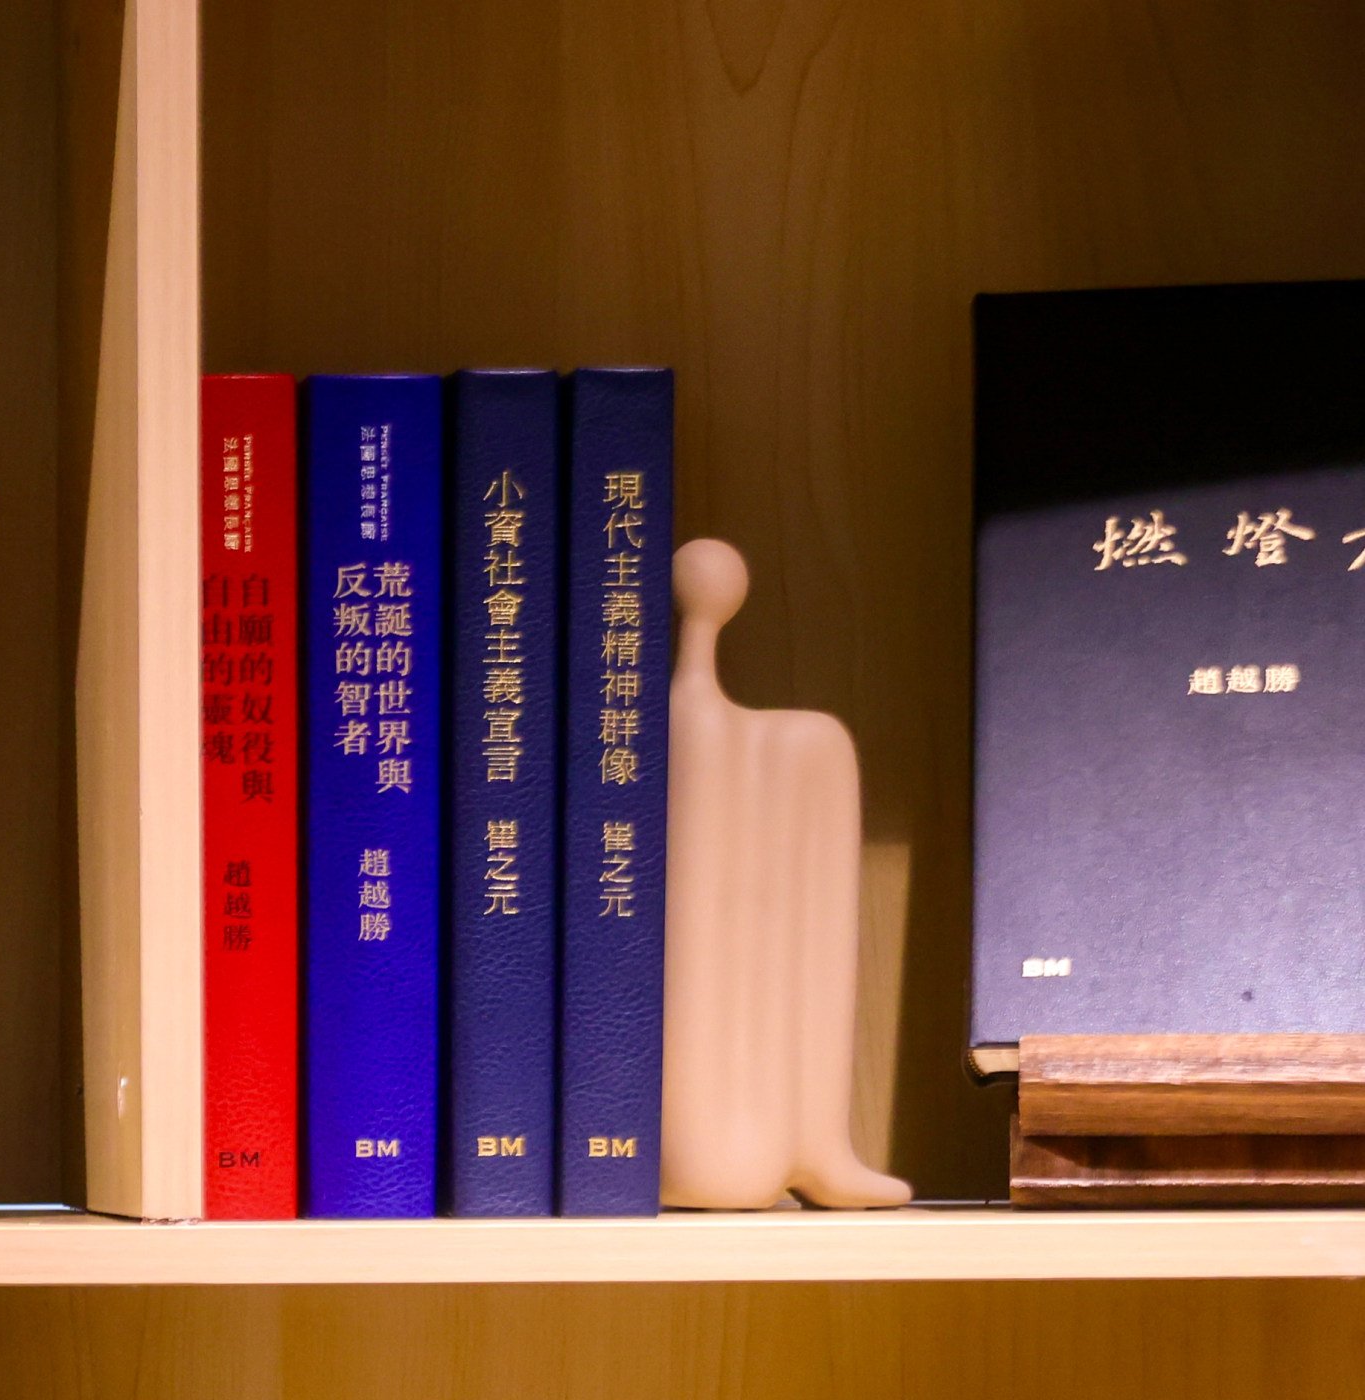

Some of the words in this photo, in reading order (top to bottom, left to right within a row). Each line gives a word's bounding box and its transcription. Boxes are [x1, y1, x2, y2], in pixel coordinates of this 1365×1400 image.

[332, 563, 372, 756] 反叛的智者
[482, 471, 524, 784] 小資社會主義宣言
[598, 472, 644, 785] 現代主義精神群像
[373, 563, 413, 796] 荒誕的世界與
[223, 860, 253, 951] 趙越勝
[357, 849, 391, 942] 趙越勝
[483, 820, 520, 916] 崔之元
[599, 821, 635, 917] 崔之元
[218, 1151, 260, 1168] BM
[355, 1139, 400, 1158] BM
[477, 1137, 525, 1158] BM
[588, 1138, 636, 1158] BM
